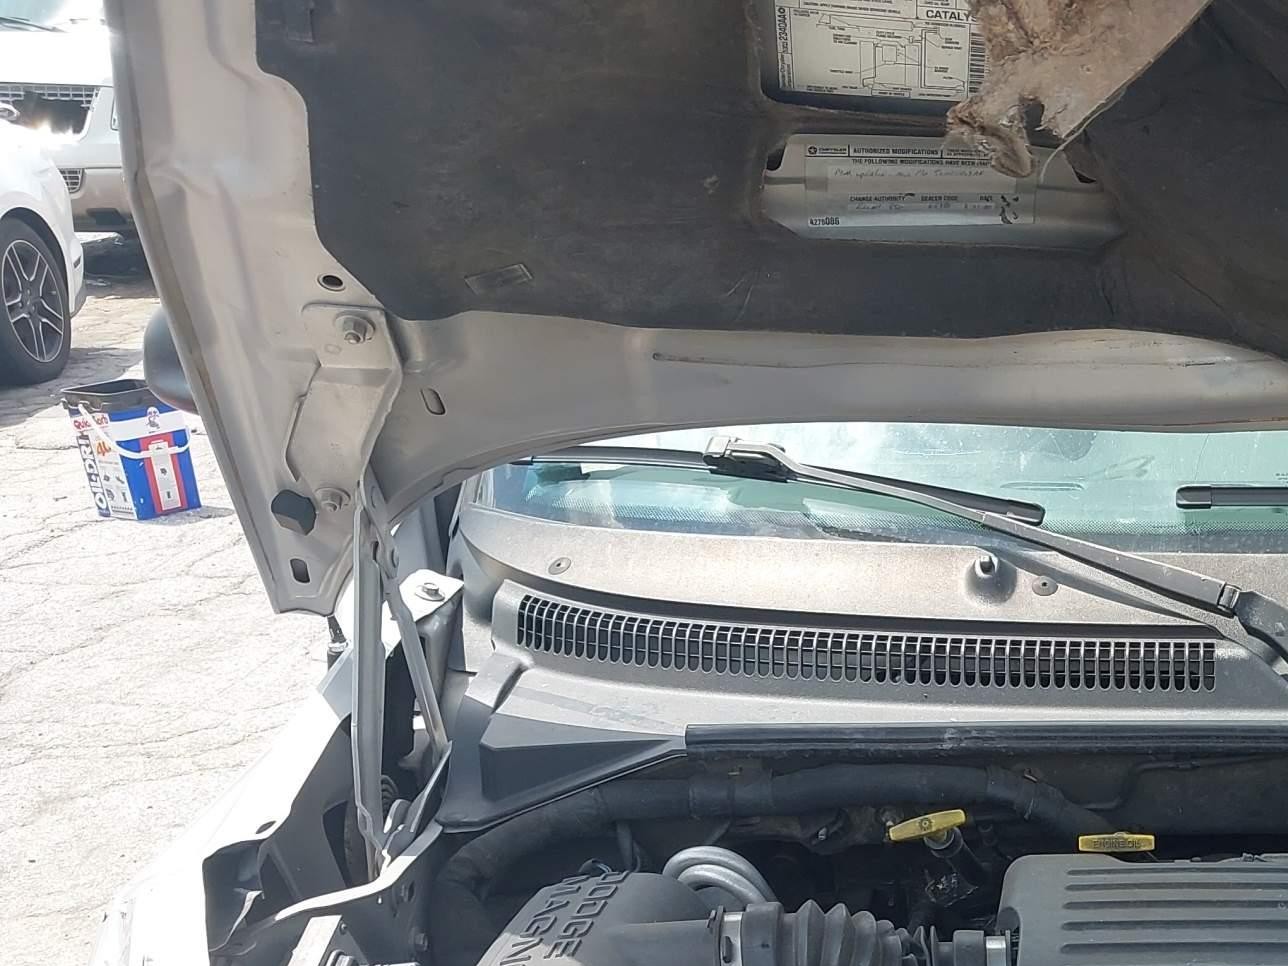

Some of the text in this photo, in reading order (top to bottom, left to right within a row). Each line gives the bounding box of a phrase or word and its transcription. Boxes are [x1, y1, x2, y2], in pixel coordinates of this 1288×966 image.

[926, 10, 977, 23] CATALYS
[891, 148, 939, 156] MODIFICATIONS
[543, 870, 630, 960] DODGE
